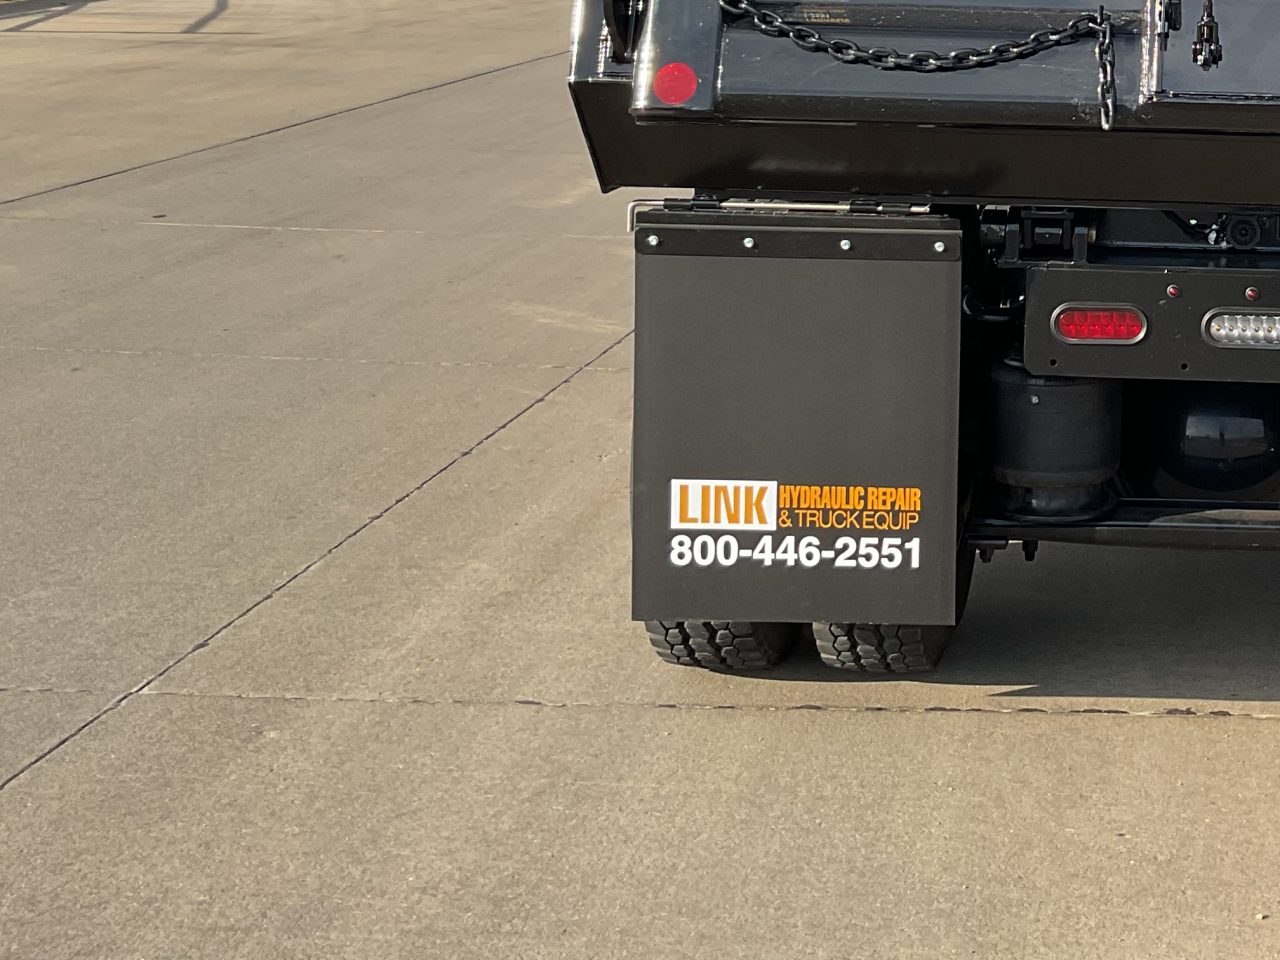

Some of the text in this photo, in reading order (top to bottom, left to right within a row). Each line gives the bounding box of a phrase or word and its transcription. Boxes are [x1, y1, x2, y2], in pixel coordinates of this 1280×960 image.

[678, 484, 769, 525] LINK
[778, 485, 922, 511] HYDRAULIC REPAIR
[778, 510, 920, 530] & TRUCK EQUIP
[670, 534, 921, 568] 800-446-2551
